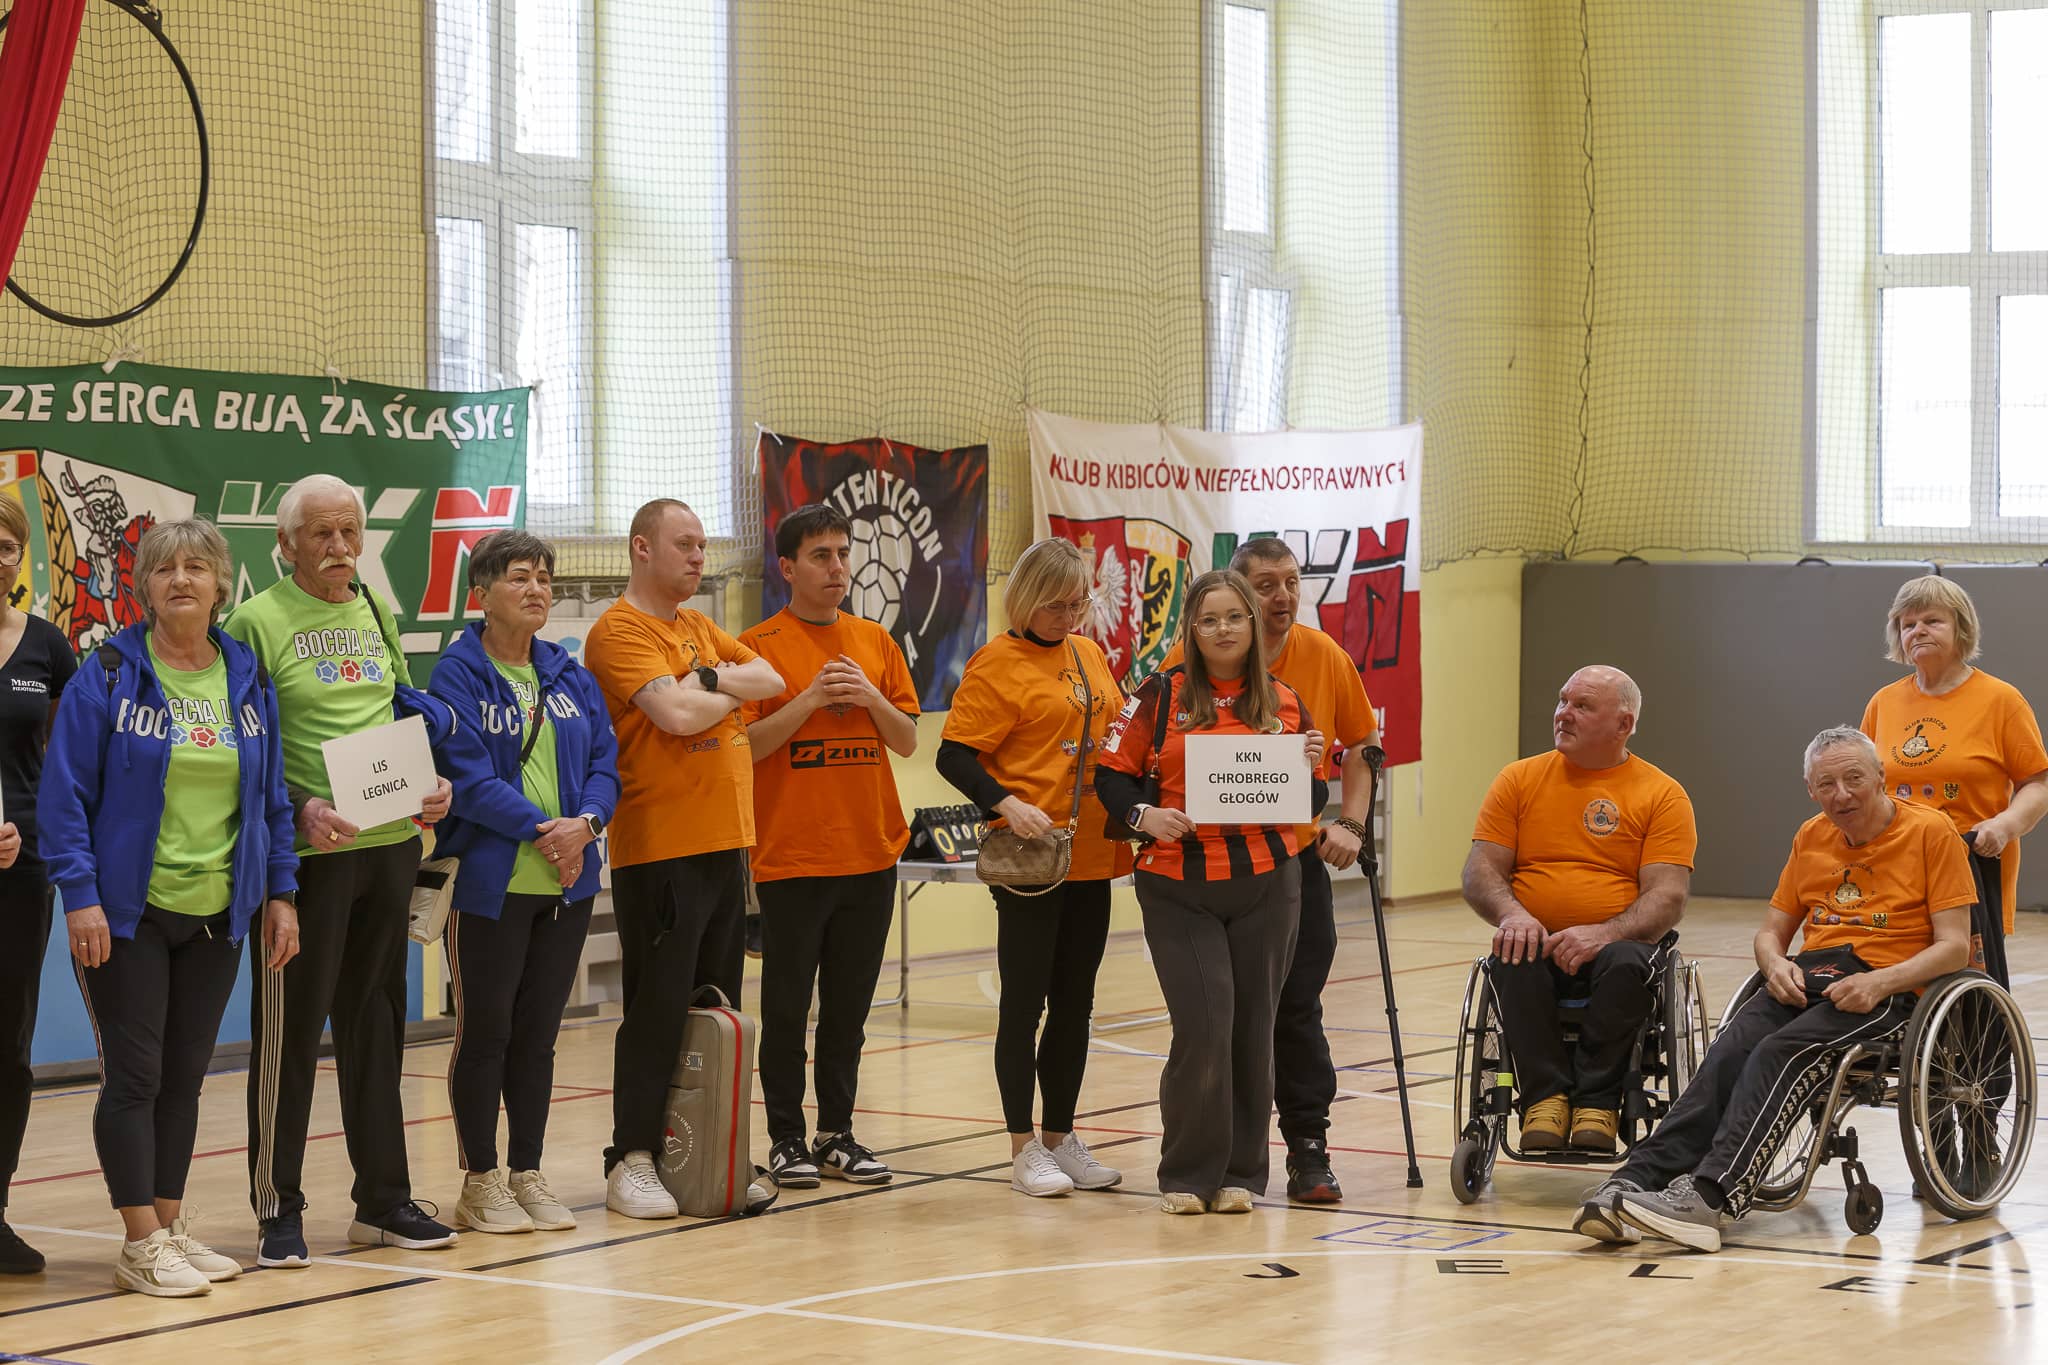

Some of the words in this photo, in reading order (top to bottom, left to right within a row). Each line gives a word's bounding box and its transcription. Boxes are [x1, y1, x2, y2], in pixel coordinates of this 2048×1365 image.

[66, 381, 201, 428] SERCA
[214, 390, 311, 443] BIJĄ
[320, 394, 376, 436] ZA
[1050, 453, 1101, 487] KLUB
[1106, 457, 1190, 491] KIBICÓW
[294, 627, 363, 660] BOCCIA
[362, 629, 384, 658] LIS
[372, 759, 389, 774] LIS
[1235, 751, 1262, 763] KKN
[362, 777, 409, 801] LEGNICA
[1208, 773, 1290, 784] CHROBREGO
[1219, 789, 1279, 804] GŁOGÓW
[1434, 1259, 1510, 1275] E
[1627, 1262, 1695, 1280] L
